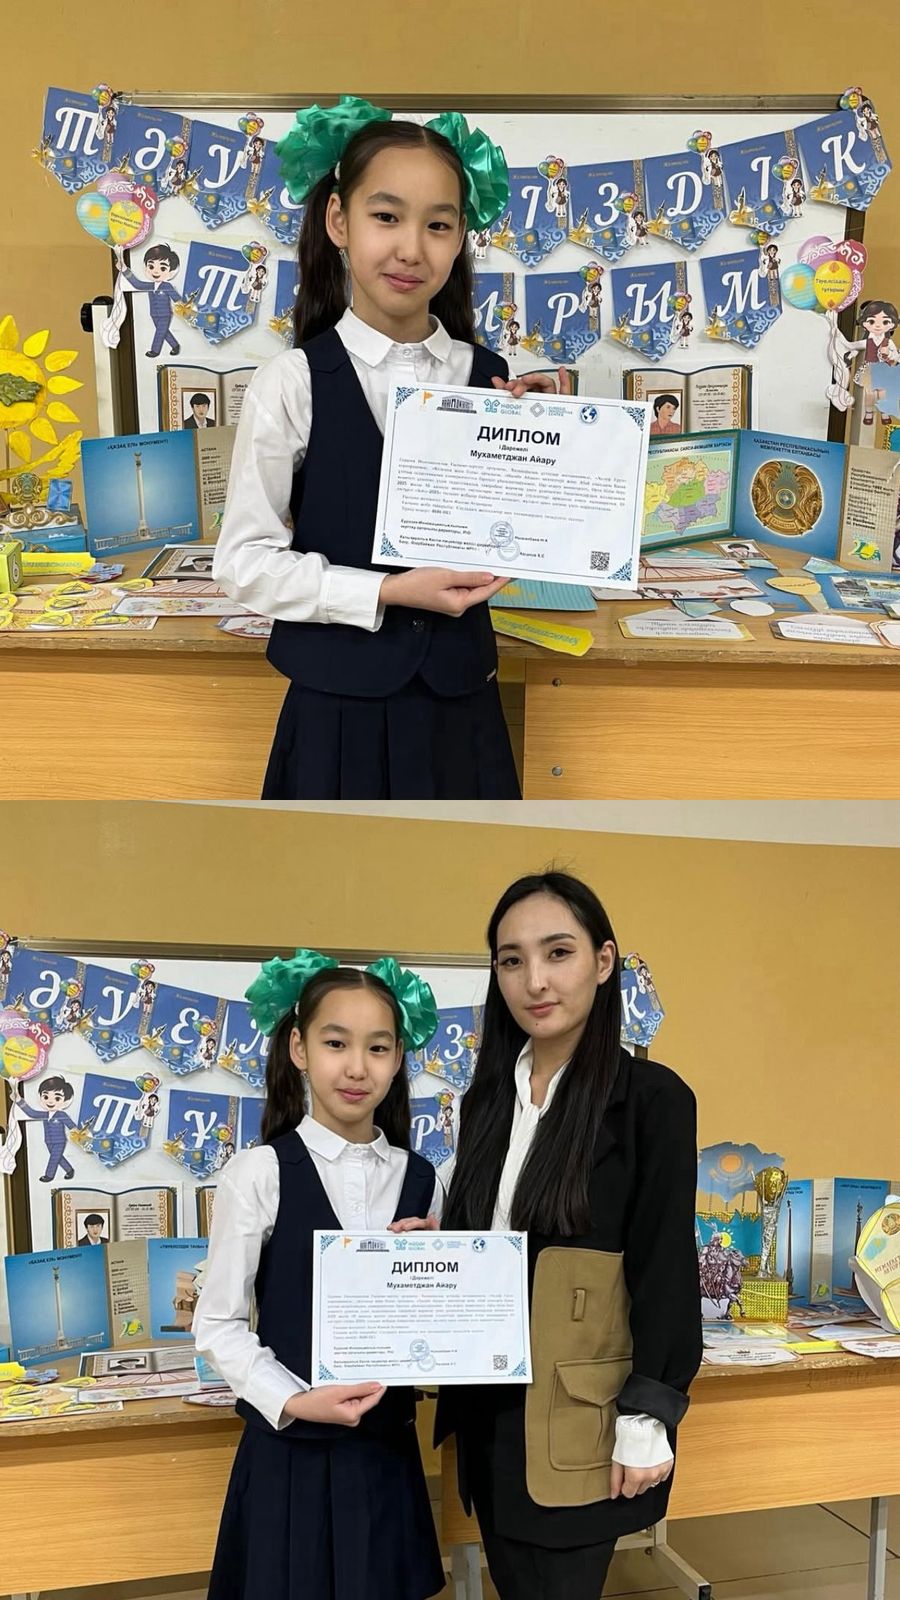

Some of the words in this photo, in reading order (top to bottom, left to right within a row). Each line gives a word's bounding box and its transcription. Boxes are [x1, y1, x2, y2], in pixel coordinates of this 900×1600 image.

[476, 426, 561, 446] ДИПЛОМ
[470, 450, 528, 462] Мухаметджан
[530, 455, 557, 467] Айару
[391, 1261, 459, 1275] ДИПЛОМ
[387, 1282, 434, 1290] Мухаметджан
